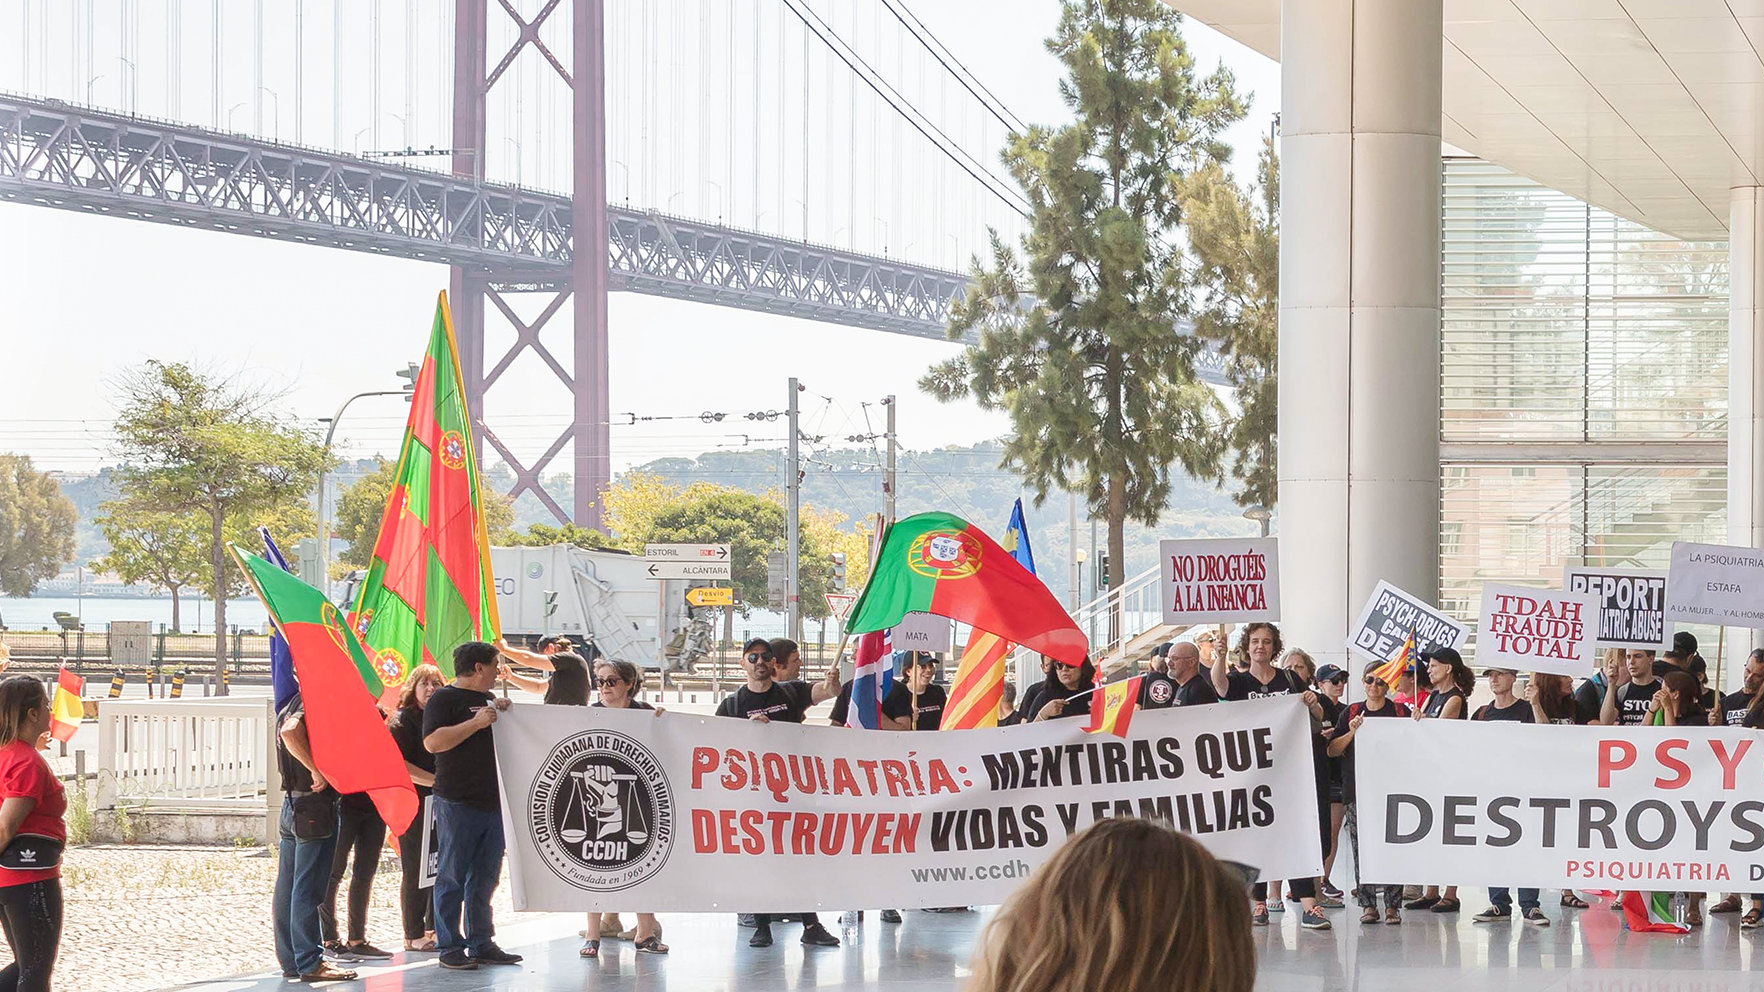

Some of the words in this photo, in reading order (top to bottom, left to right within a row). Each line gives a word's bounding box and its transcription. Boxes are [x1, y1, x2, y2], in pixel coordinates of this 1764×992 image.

[1171, 555, 1195, 582] NO
[1197, 548, 1267, 582] DROGUÉIS
[1689, 553, 1702, 563] LA
[1704, 554, 1764, 568] PSIQUIATRIA
[1173, 585, 1184, 612] A
[1186, 584, 1205, 612] LA
[1207, 583, 1268, 612] INFANCIA
[1707, 582, 1741, 593] ESTAFA
[1495, 594, 1583, 621] TDAH
[1677, 605, 1687, 613] LA
[905, 631, 928, 641] MATA
[1381, 619, 1430, 654] CAUE
[1416, 612, 1457, 648] DRUGS
[1489, 613, 1584, 643] FRAUDE
[1631, 610, 1663, 641] ABUSE
[1496, 633, 1582, 661] TOTAL
[691, 746, 973, 803] PSIQUIATRÍA:
[981, 736, 1185, 791] MENTIRAS
[1194, 727, 1273, 779] QUE
[545, 738, 595, 783] CIUDADANA
[597, 736, 609, 750] DE
[612, 738, 660, 783] DERECHOS
[654, 781, 671, 843] HUMANOS
[691, 809, 922, 856] DESTRUYEN
[930, 804, 1048, 852] VIDAS
[1055, 802, 1079, 838] Y
[581, 840, 628, 861] CCDH
[567, 867, 606, 885] Fundada
[608, 876, 619, 885] en
[622, 866, 644, 883] 1969
[1566, 860, 1731, 881] PSIQUIATRIA
